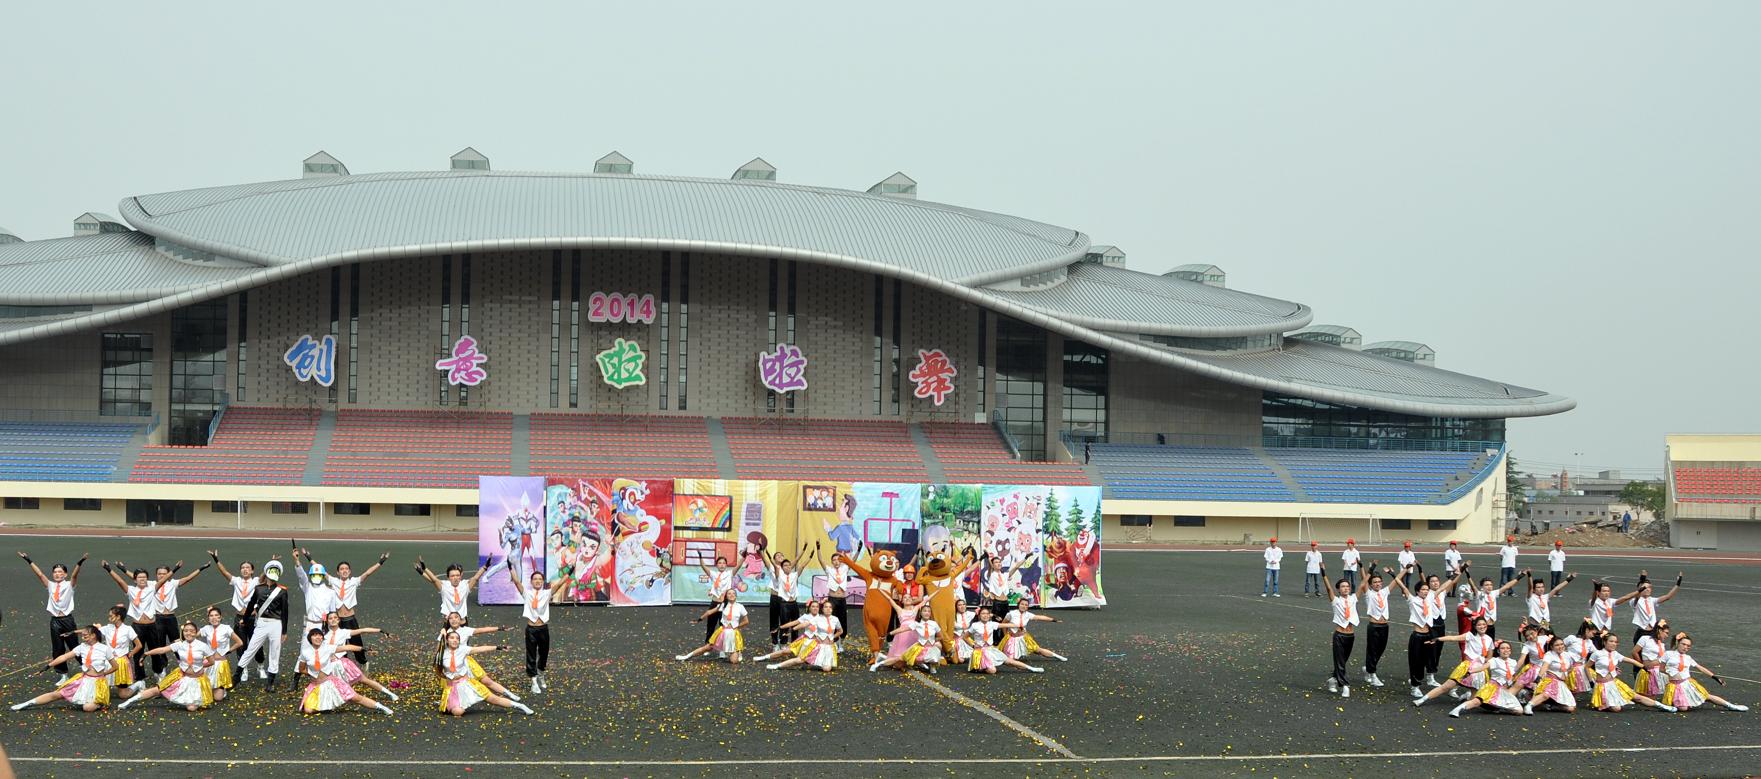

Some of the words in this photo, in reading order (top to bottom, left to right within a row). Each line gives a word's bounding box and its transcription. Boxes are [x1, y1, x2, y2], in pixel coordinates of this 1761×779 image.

[589, 294, 655, 322] 2014
[286, 336, 334, 385] 创
[437, 337, 486, 384] 意
[597, 339, 645, 387] 啦
[760, 345, 806, 392] 啦
[910, 350, 956, 404] 舞
